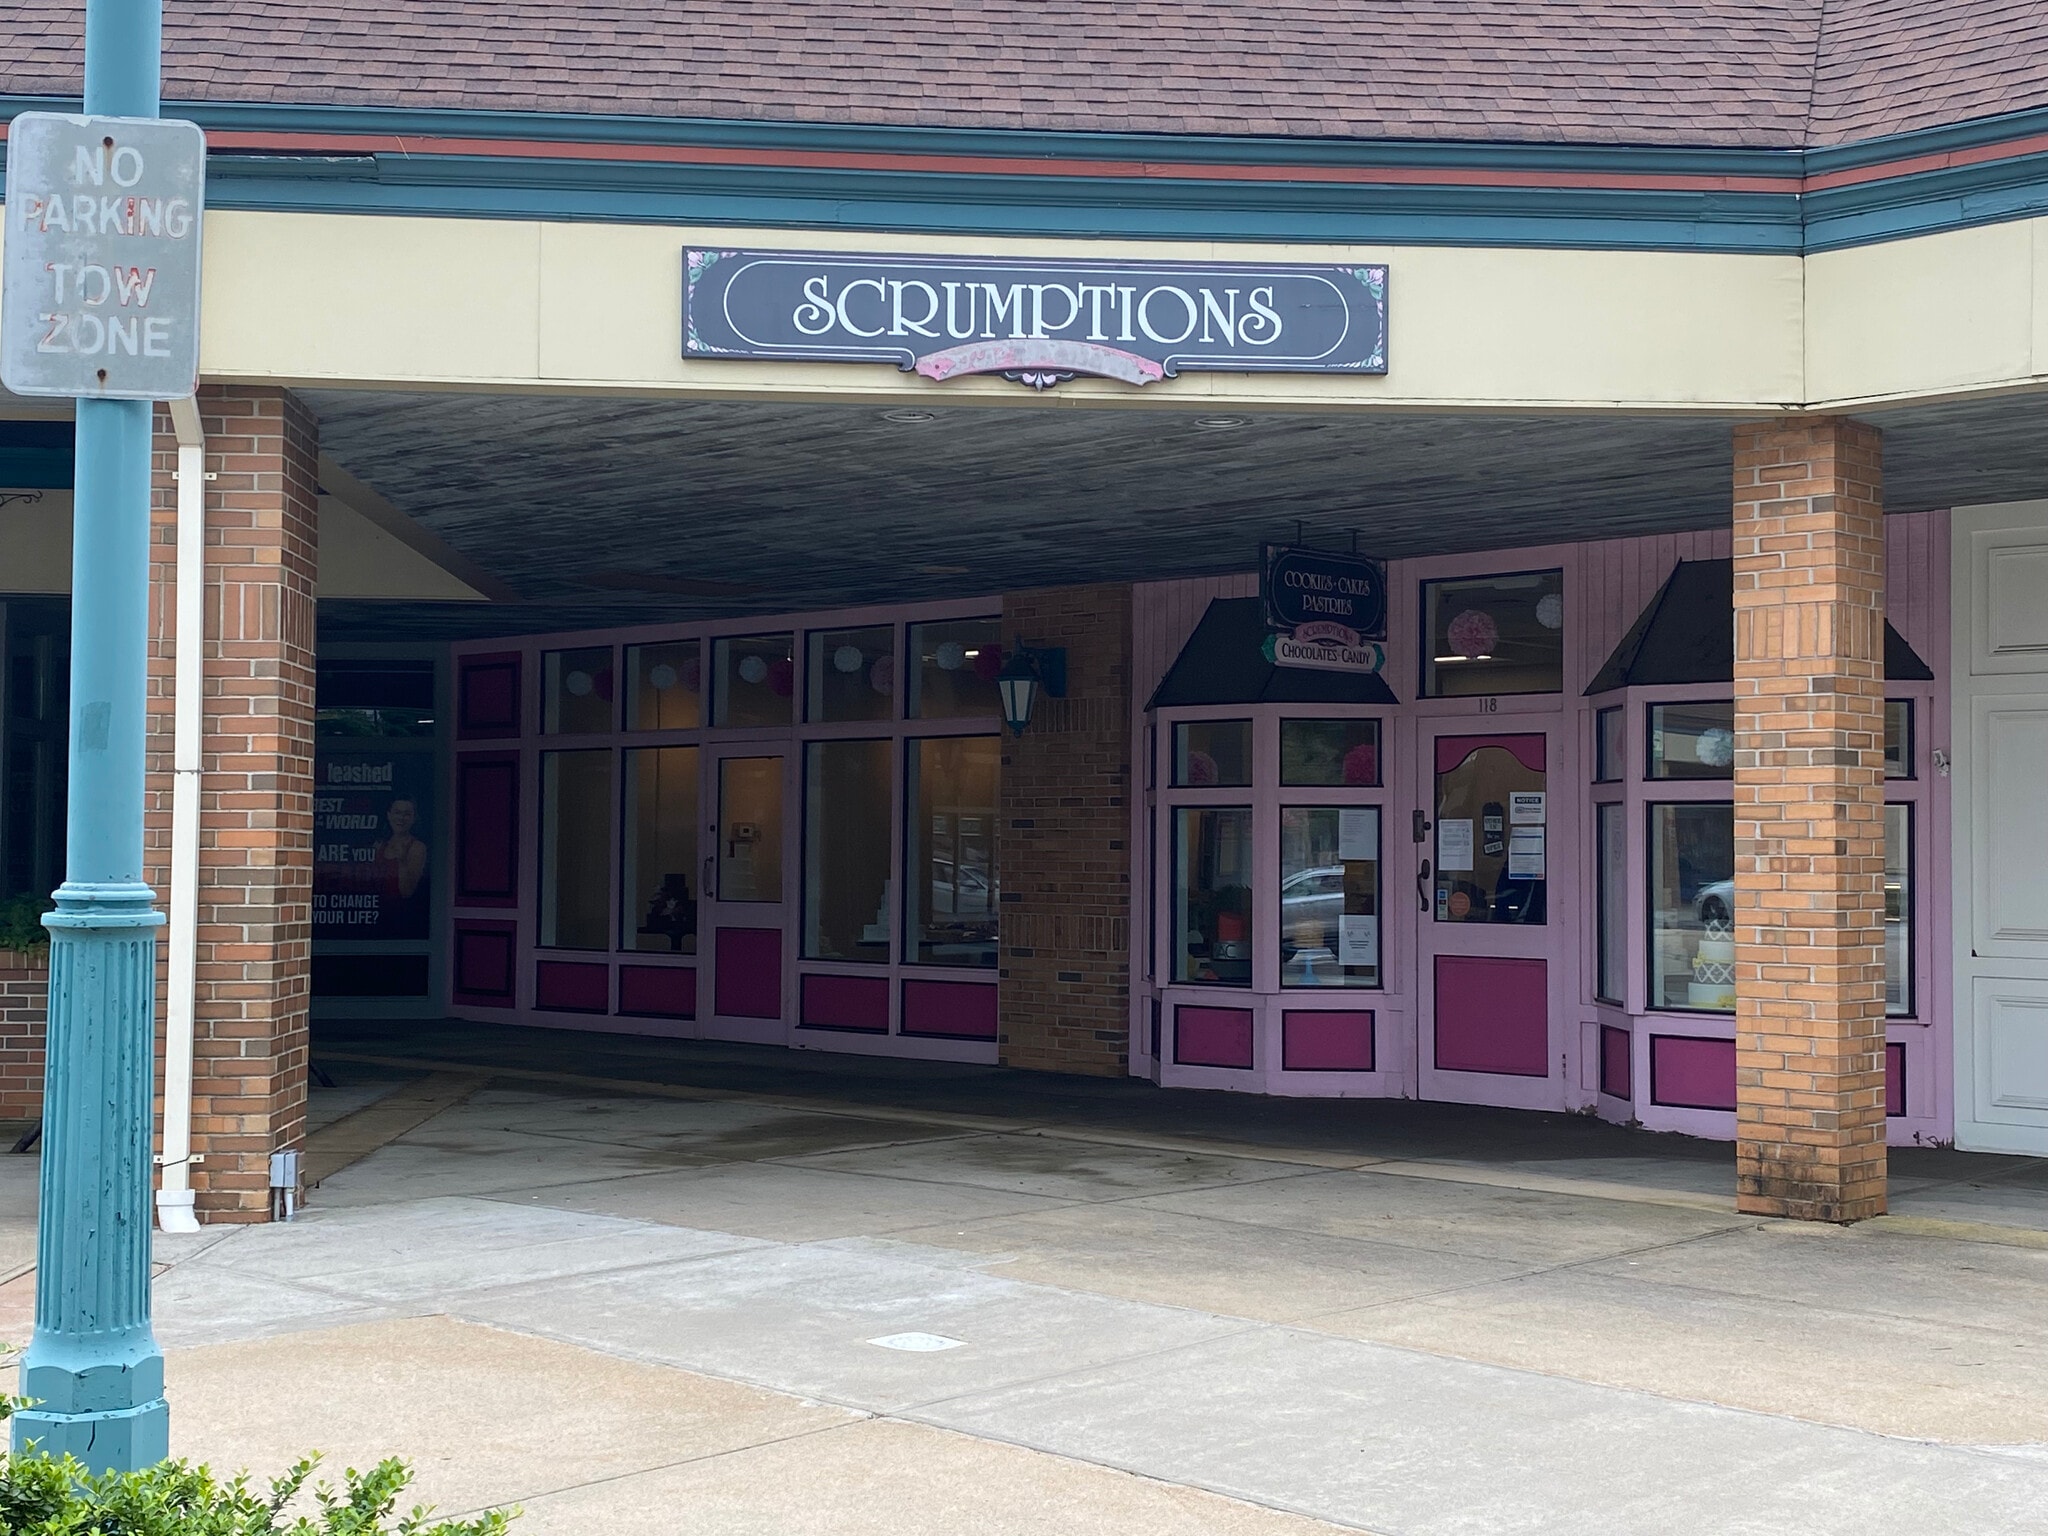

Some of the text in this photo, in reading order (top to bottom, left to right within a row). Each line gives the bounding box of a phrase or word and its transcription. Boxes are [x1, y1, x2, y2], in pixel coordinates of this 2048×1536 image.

[74, 145, 144, 187] NO
[19, 194, 193, 239] PARKING
[46, 263, 156, 307] TOW
[792, 275, 1283, 347] SCRUMPTIONS
[37, 313, 171, 357] ZONE
[1284, 570, 1371, 597] COOKIES CAKES
[1302, 594, 1353, 616] PASTRIES
[1282, 643, 1371, 665] CHOCOLATES CANDY
[1479, 697, 1497, 713] 118
[326, 814, 379, 830] WORLD
[318, 844, 376, 862] ARE YOU
[313, 894, 380, 908] TO CHANGE
[312, 910, 380, 924] YOUR LIFE?
